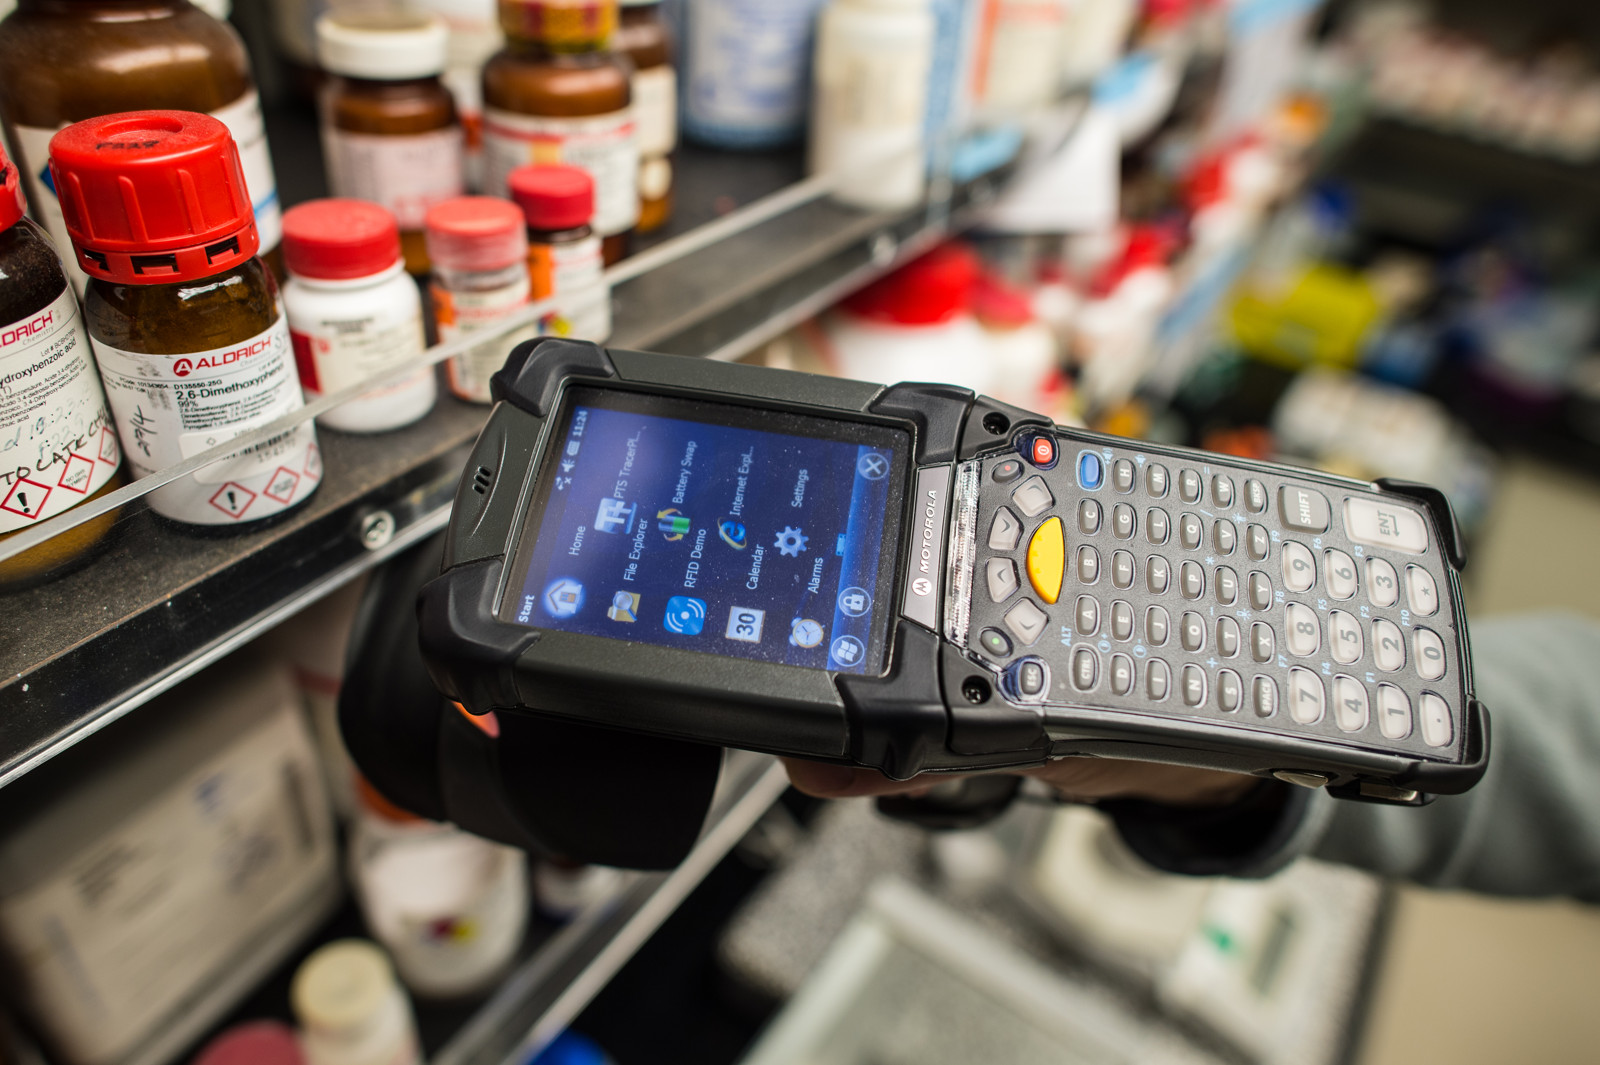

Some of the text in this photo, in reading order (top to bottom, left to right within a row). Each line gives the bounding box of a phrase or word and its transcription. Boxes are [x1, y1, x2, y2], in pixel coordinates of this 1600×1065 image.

[0, 310, 53, 348] DRICH
[41, 346, 50, 357] Lot
[64, 336, 77, 353] acid
[196, 335, 272, 370] ALDRICH
[573, 410, 588, 437] 11:24
[672, 440, 697, 504] Battery Swap
[1120, 468, 1130, 477] H
[1153, 473, 1163, 484] M
[614, 476, 628, 499] PTS
[791, 468, 810, 508] Settings
[1186, 478, 1196, 487] R
[1219, 482, 1230, 493] W
[730, 476, 747, 517] Internet
[1252, 481, 1262, 504] BKSP
[1086, 510, 1096, 519] C
[1298, 491, 1312, 525] SHIFT
[1120, 515, 1130, 524] G
[1378, 510, 1391, 536] ENT
[919, 490, 937, 574] MOTOROLA
[1187, 524, 1197, 534] Q
[1221, 529, 1233, 539] V
[568, 525, 586, 556] Home
[1255, 535, 1265, 545] Z
[1271, 530, 1282, 543] F9
[1313, 537, 1323, 550] F6
[623, 517, 648, 581] File Explorer
[1354, 545, 1364, 558] F3
[684, 528, 707, 588] RFID Demo
[1084, 559, 1094, 567] B
[1292, 558, 1311, 572] 9
[746, 543, 765, 590] Calendar
[1119, 565, 1129, 573] F
[1153, 568, 1164, 578] K
[1334, 567, 1353, 580] 6
[807, 557, 824, 594] Alarms
[1189, 574, 1199, 582] P
[1375, 575, 1393, 589] 3
[1223, 579, 1233, 588] U
[1257, 584, 1268, 593] Y
[1275, 590, 1285, 603] F8
[518, 594, 535, 623] Start
[1317, 598, 1328, 611] F5
[1360, 605, 1370, 618] F2
[1082, 610, 1093, 619] A
[1118, 616, 1129, 624] E
[1401, 609, 1411, 627] F10
[736, 612, 756, 636] 30
[1296, 621, 1315, 636] 8
[1061, 626, 1072, 647] ALT
[1259, 637, 1270, 646] X
[1340, 630, 1358, 644] 5
[1382, 636, 1399, 652] 2
[1278, 653, 1289, 668] F7
[1423, 646, 1441, 661] 0
[1081, 658, 1092, 680] CTRL
[1116, 669, 1127, 678] D
[1322, 662, 1332, 675] F4
[1026, 669, 1038, 687] ESC
[1365, 671, 1376, 683] F1
[1189, 680, 1200, 691] N
[1225, 687, 1237, 695] S
[1261, 682, 1273, 712] SPACE
[1299, 688, 1319, 703] 7
[1343, 698, 1362, 713] 4
[1387, 706, 1405, 717] 1
